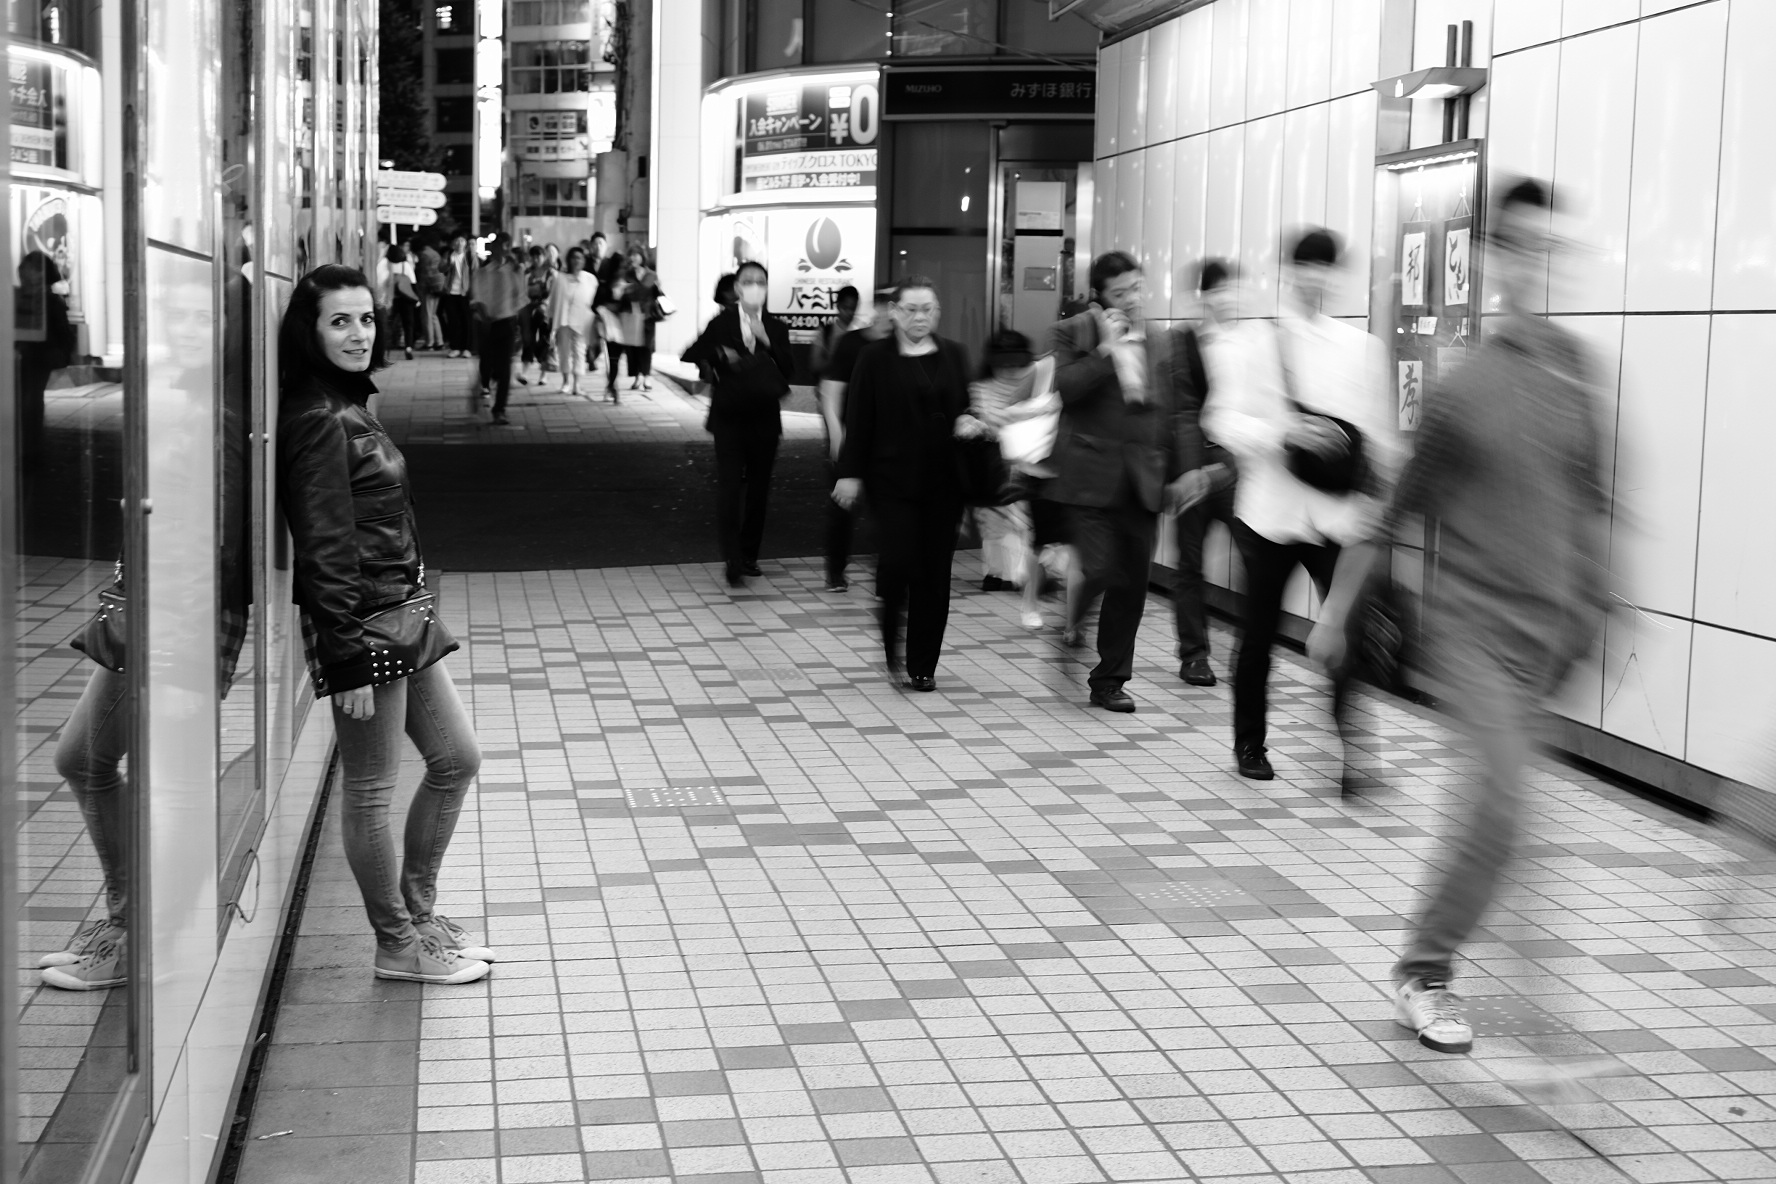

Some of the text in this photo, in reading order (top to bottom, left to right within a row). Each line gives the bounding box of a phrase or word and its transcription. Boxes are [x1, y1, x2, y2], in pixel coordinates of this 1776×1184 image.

[1010, 82, 1092, 98] みずほ銀行
[749, 113, 822, 136] 入会キャンペーン
